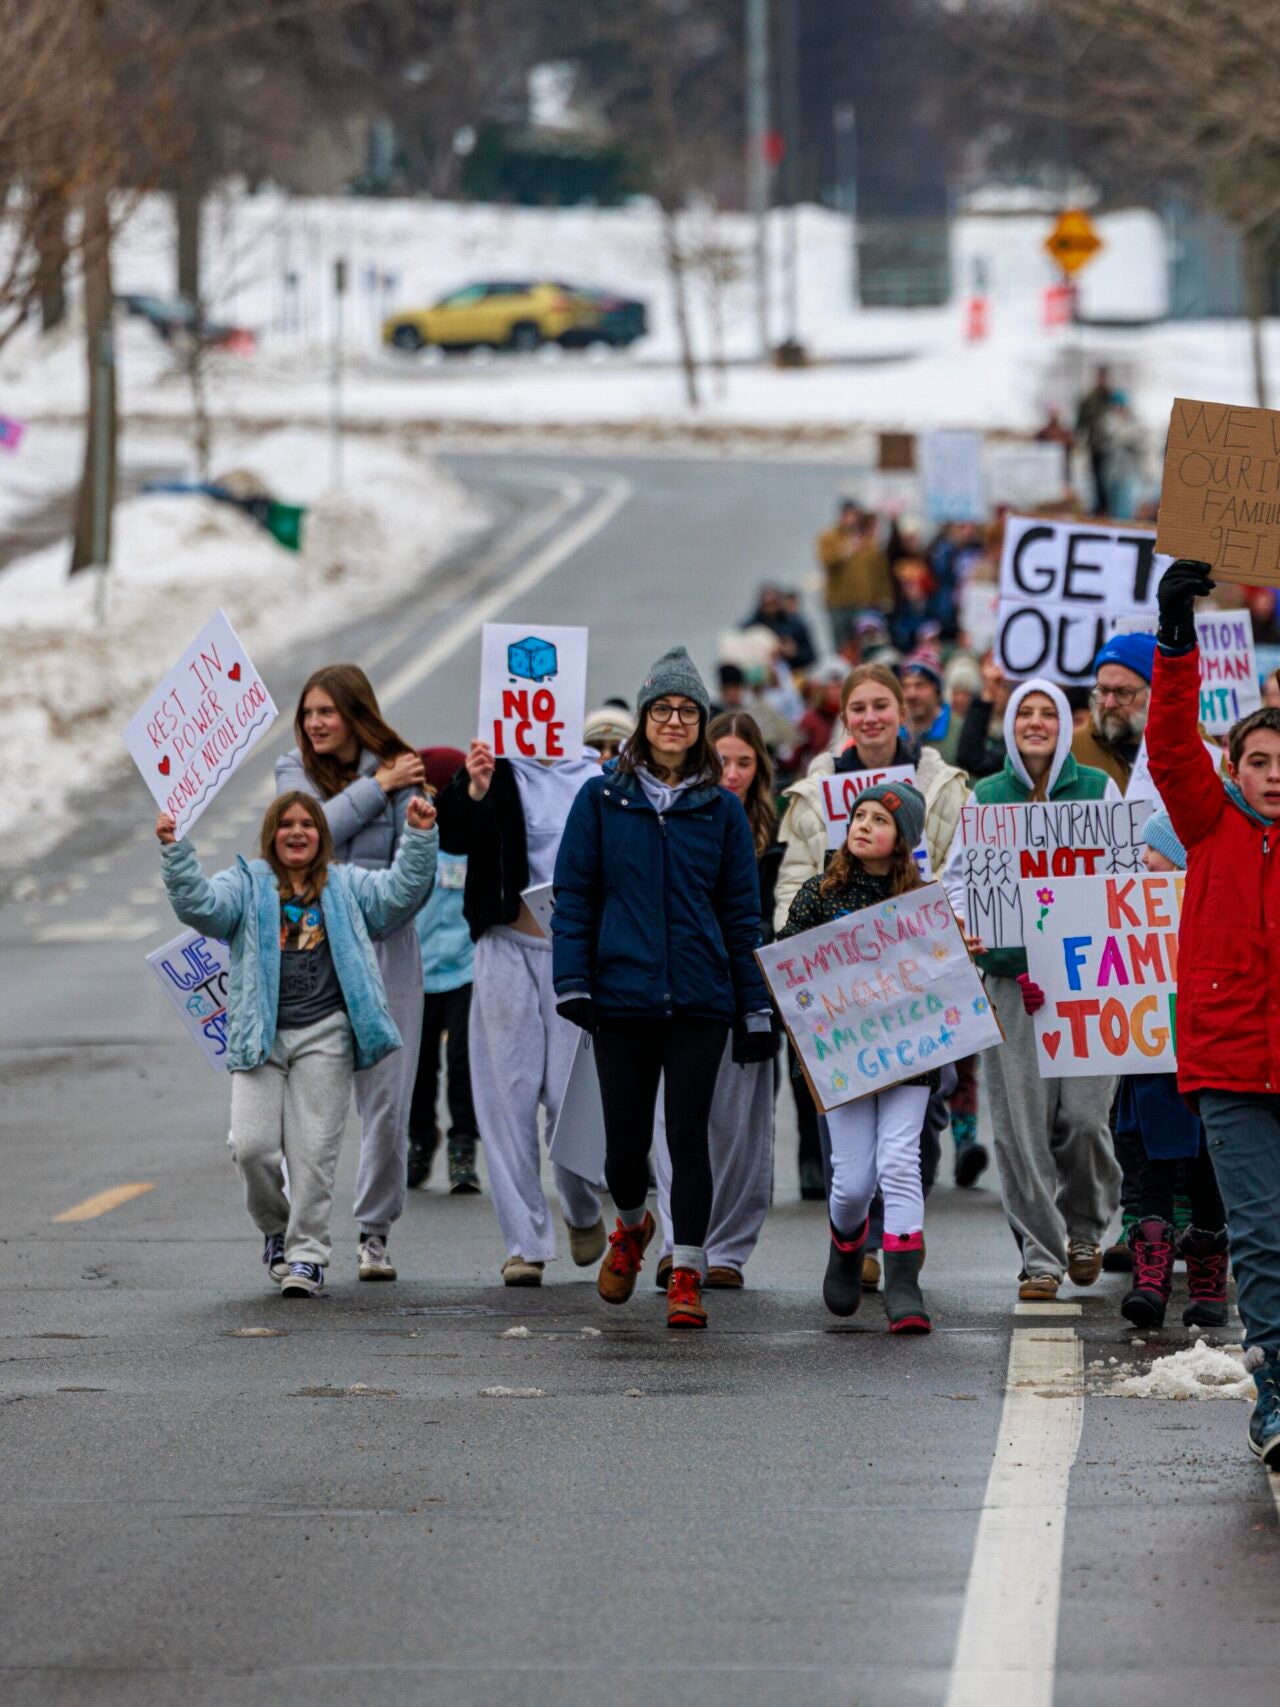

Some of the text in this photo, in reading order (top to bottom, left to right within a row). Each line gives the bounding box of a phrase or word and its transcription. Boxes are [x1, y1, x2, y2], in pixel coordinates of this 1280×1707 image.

[1180, 404, 1257, 449] WE
[1179, 452, 1251, 491] OUR
[1012, 526, 1157, 603] GET
[1001, 607, 1117, 678] OU
[1198, 623, 1247, 650] TION
[147, 643, 222, 749] REST IN
[502, 689, 556, 722] NO
[167, 681, 267, 820] RENEE NICOLE GOOD
[172, 690, 223, 762] POWER
[493, 720, 565, 757] ICE
[960, 800, 1146, 849] FIGHT IGNORANCE
[1020, 848, 1105, 879] NOT
[161, 937, 221, 990] WE
[777, 900, 950, 989] IMMIGRANTS
